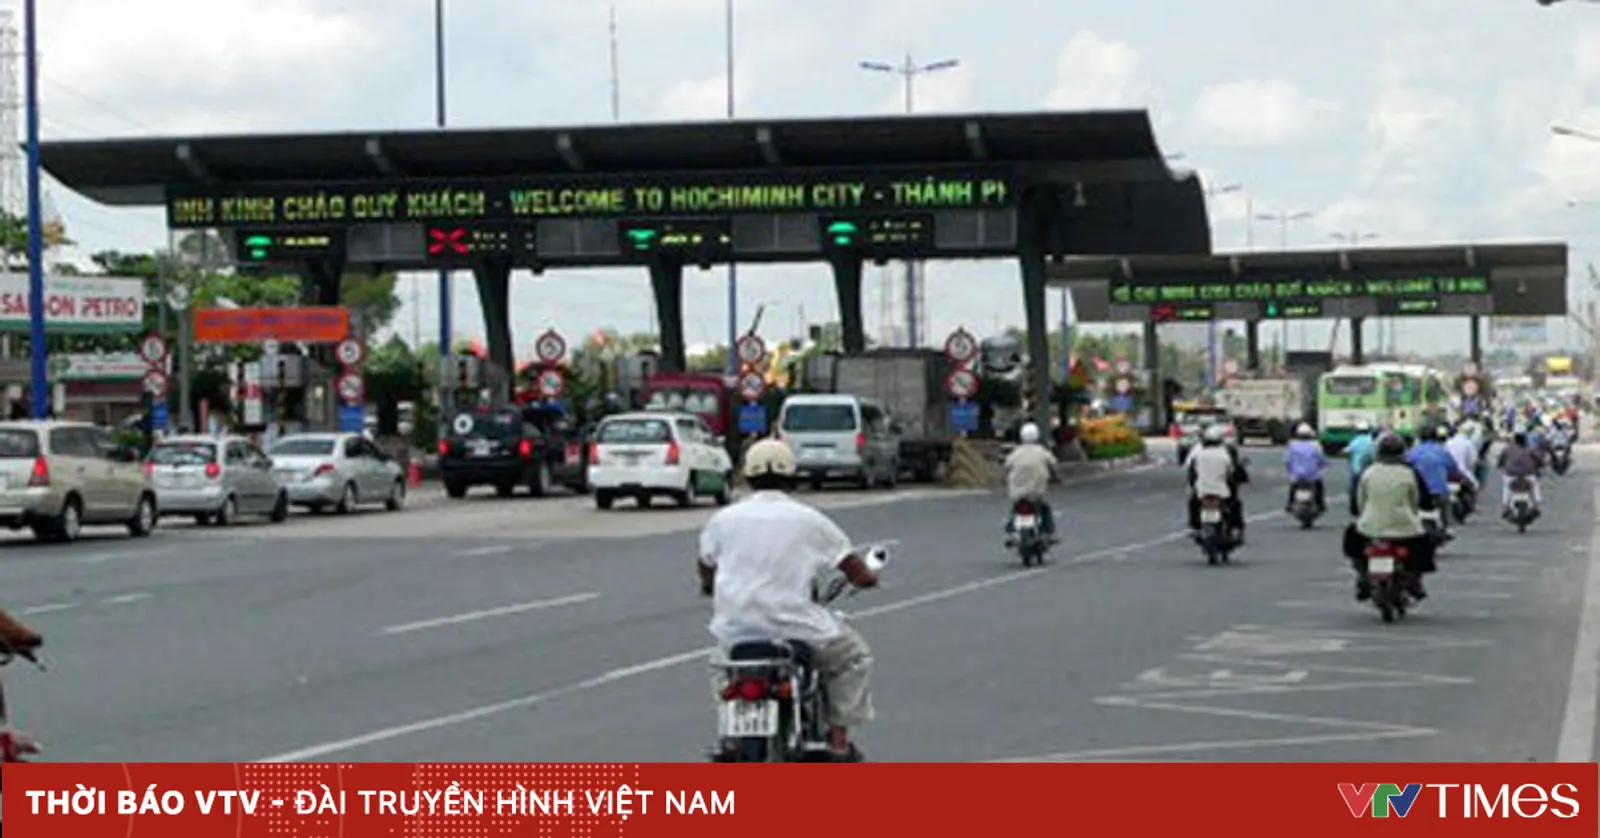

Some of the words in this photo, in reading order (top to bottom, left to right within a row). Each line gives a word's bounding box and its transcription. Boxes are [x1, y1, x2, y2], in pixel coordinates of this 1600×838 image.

[510, 188, 625, 214] WELCOME
[634, 187, 664, 212] TO
[671, 184, 805, 211] HOCHIMINH
[812, 180, 864, 208] CITY
